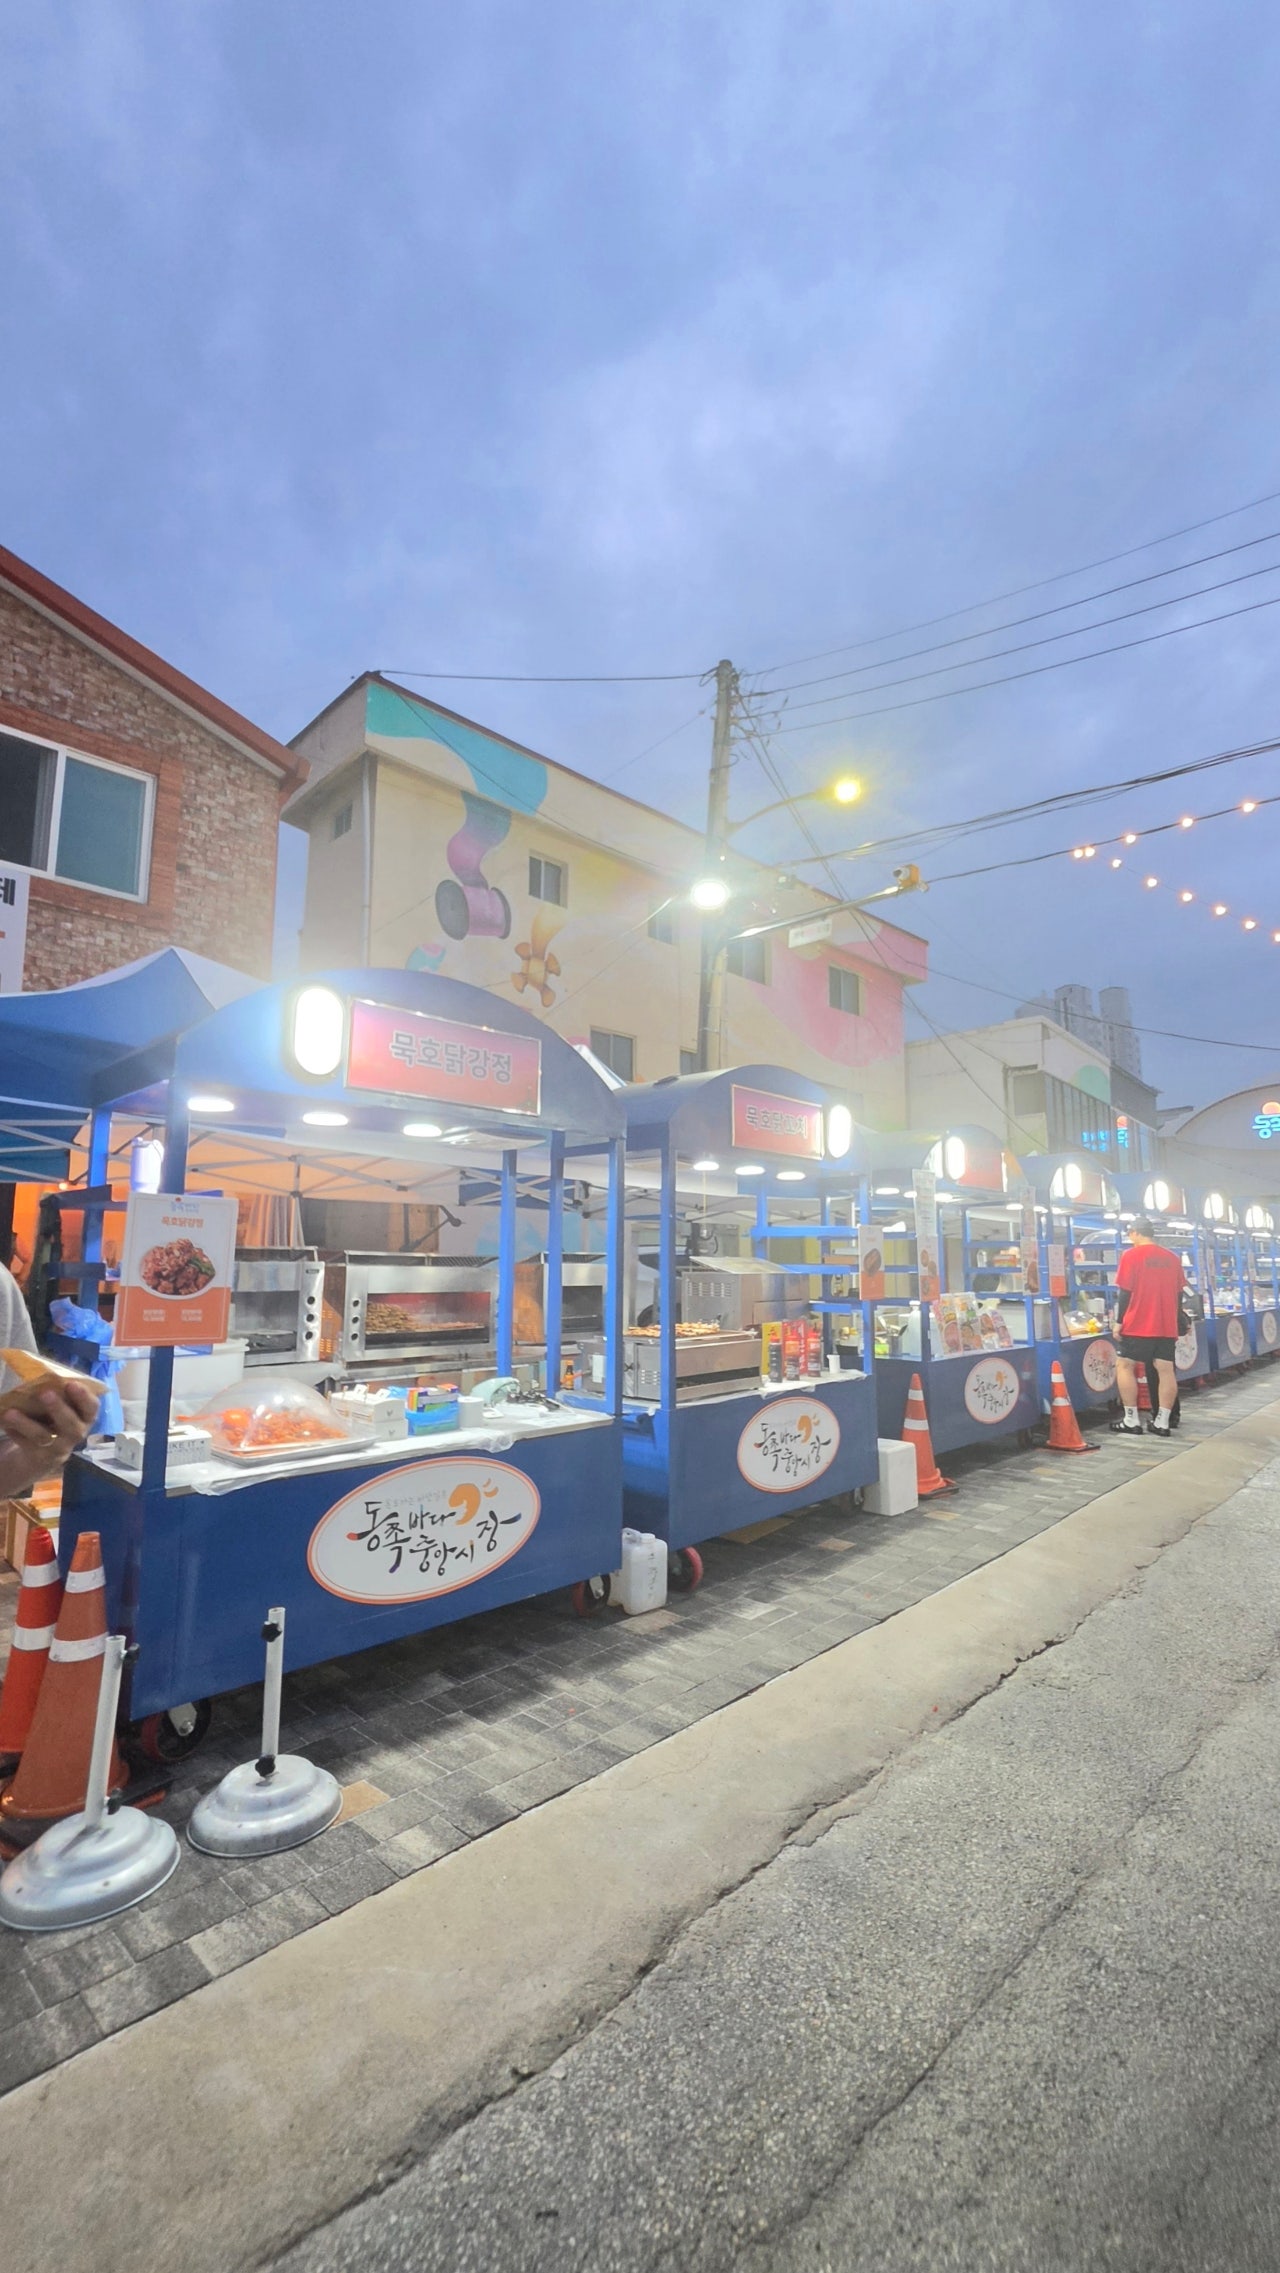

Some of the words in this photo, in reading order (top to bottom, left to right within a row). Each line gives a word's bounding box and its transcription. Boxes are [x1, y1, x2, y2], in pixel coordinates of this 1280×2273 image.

[390, 1031, 512, 1084] 묵호닭강정
[746, 1105, 807, 1138] 묵호닭꼬치
[346, 1502, 456, 1573] 동쪽바다
[409, 1510, 522, 1576] 중앙시장
